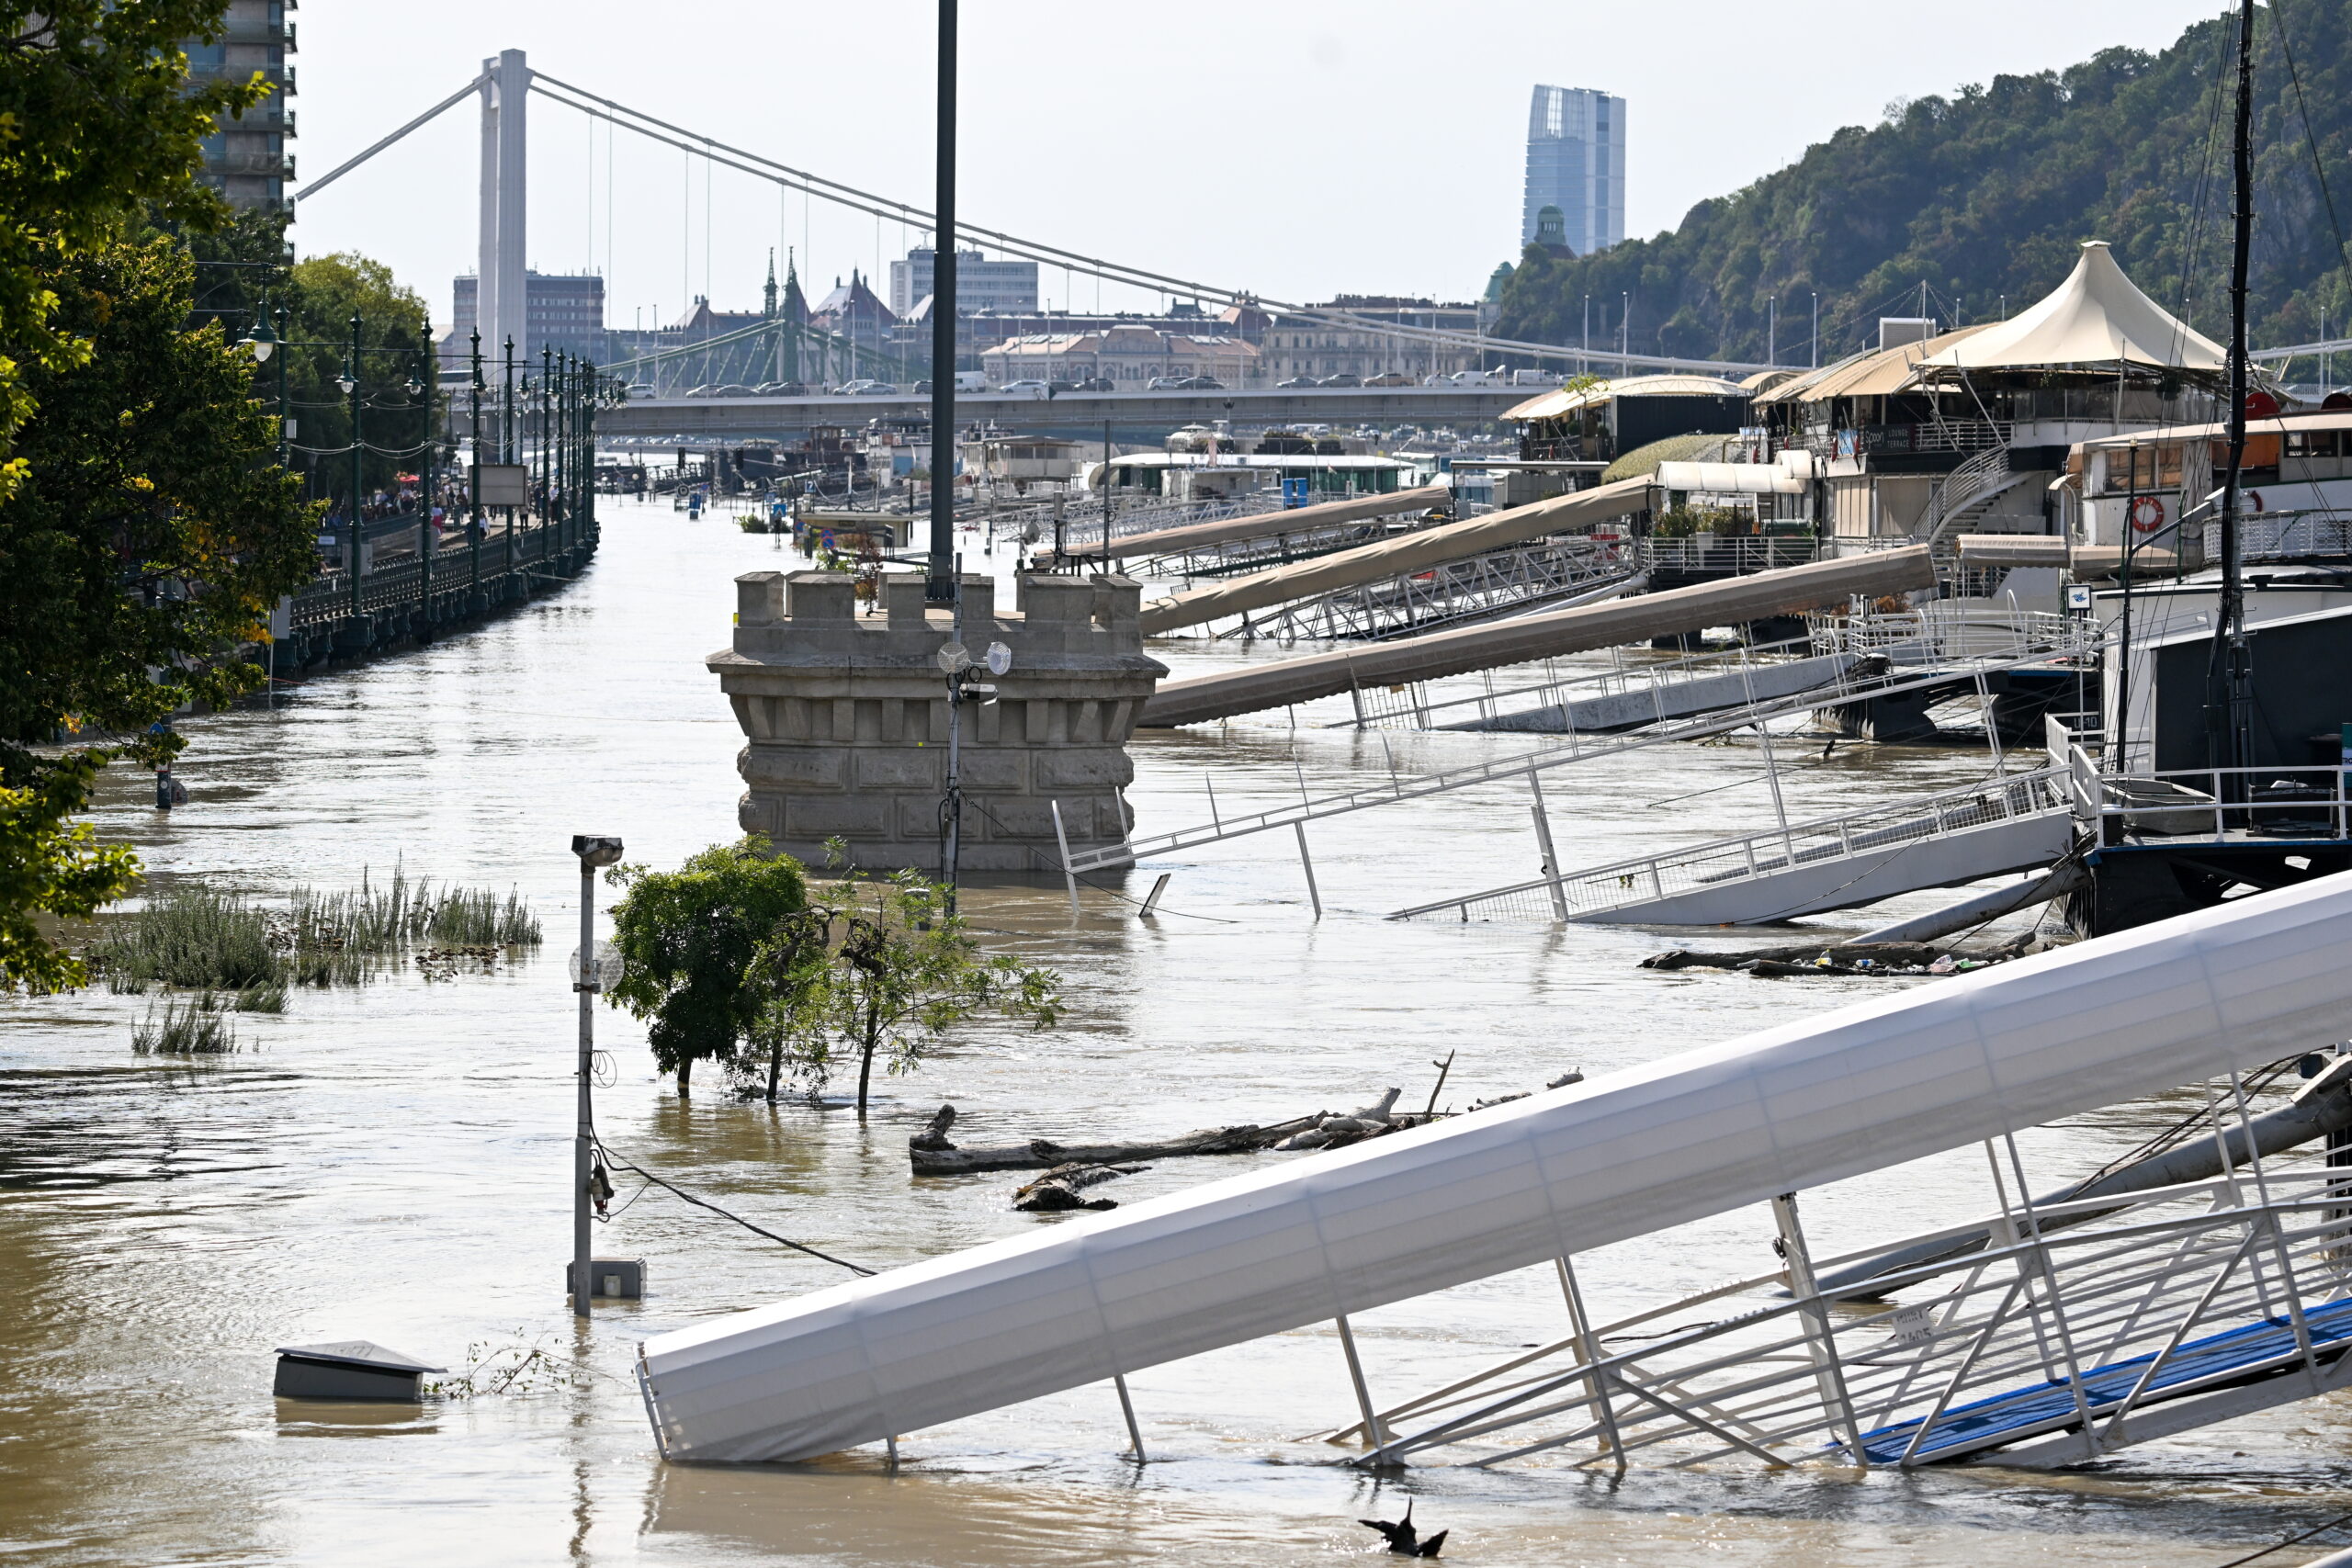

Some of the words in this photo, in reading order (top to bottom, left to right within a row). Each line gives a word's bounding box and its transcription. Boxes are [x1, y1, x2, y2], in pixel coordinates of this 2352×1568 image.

[1888, 429, 1908, 437] LOUNGE
[1865, 430, 1884, 450] Spoon
[1887, 439, 1910, 448] TERRACE
